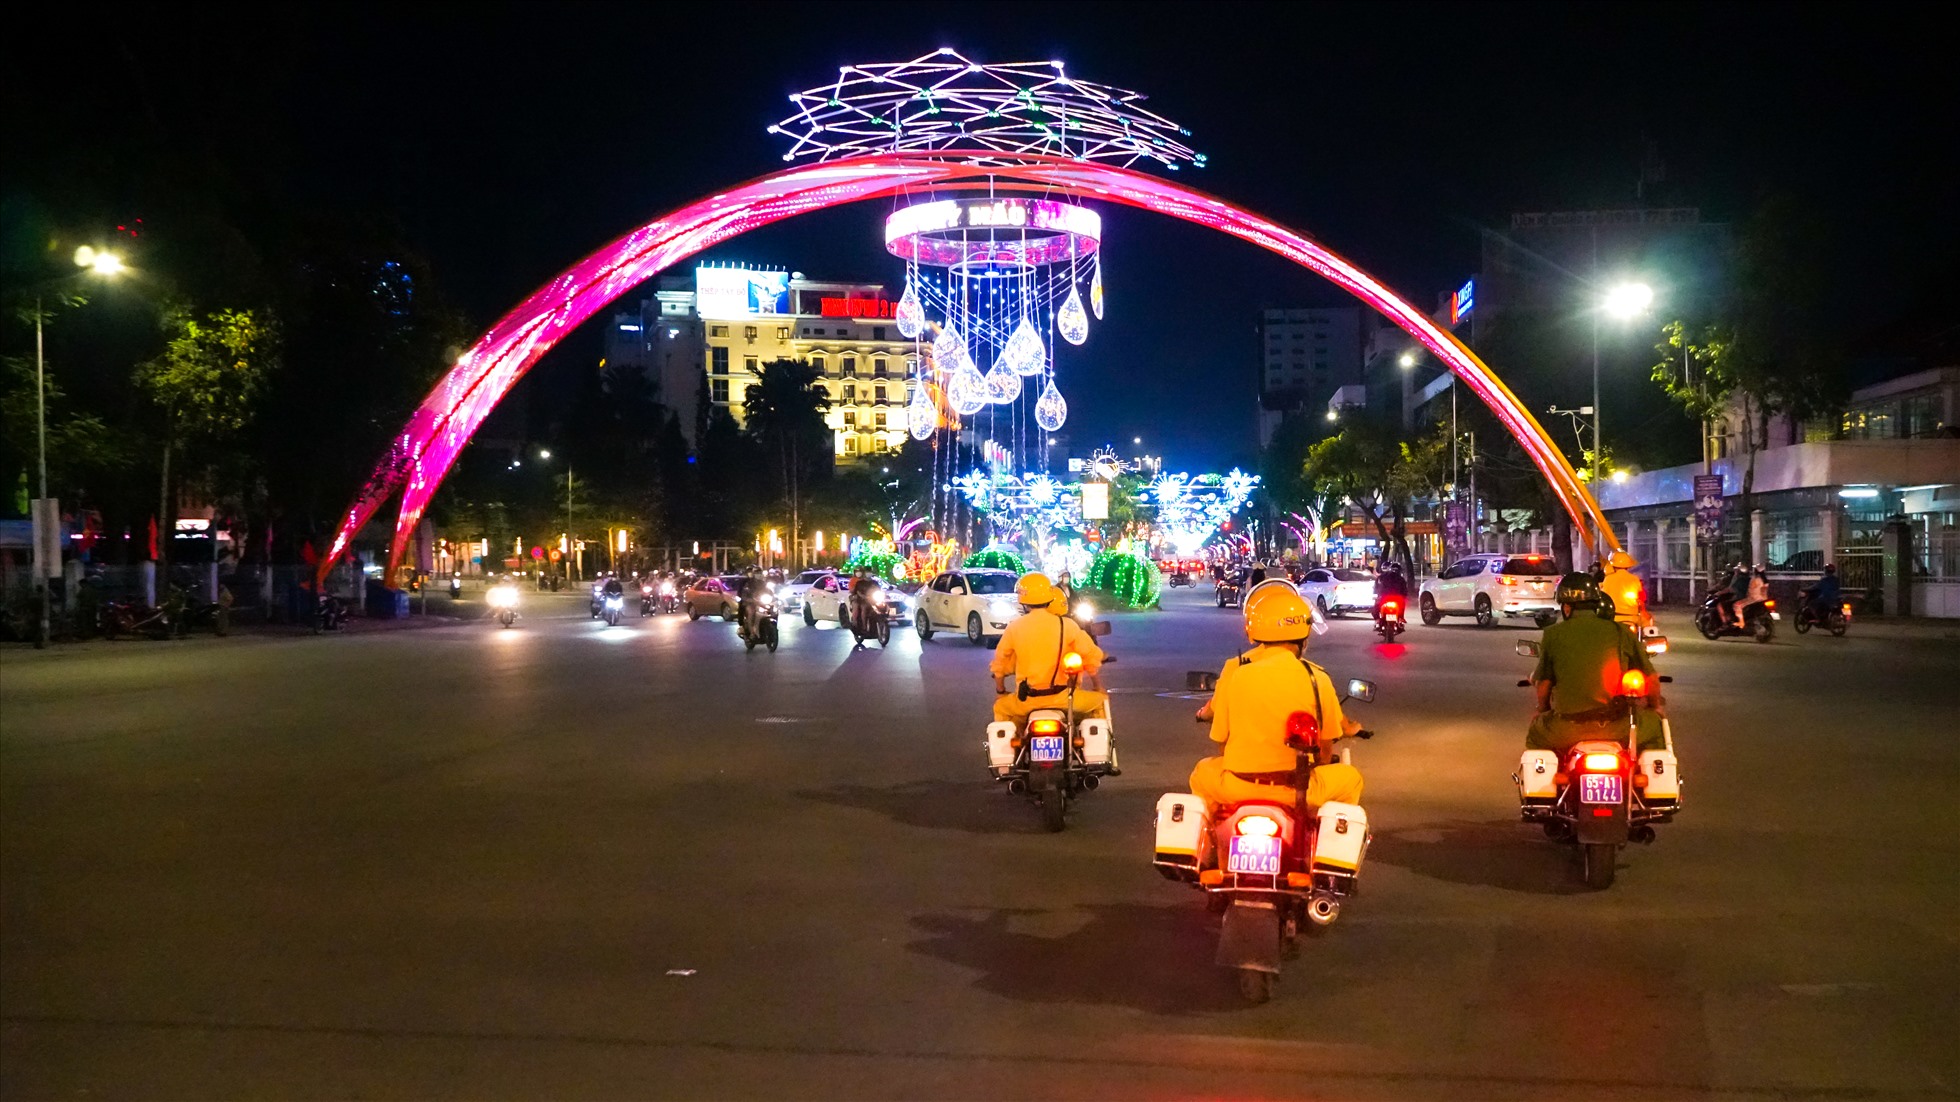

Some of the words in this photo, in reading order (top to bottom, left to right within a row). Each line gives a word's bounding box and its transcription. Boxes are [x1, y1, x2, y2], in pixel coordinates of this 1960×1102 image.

[1036, 738, 1059, 749] 65-A1
[1586, 776, 1616, 789] 65-A1
[1586, 789, 1617, 802] 0144
[1237, 837, 1273, 854] 65A1
[1231, 854, 1278, 872] 000.40
